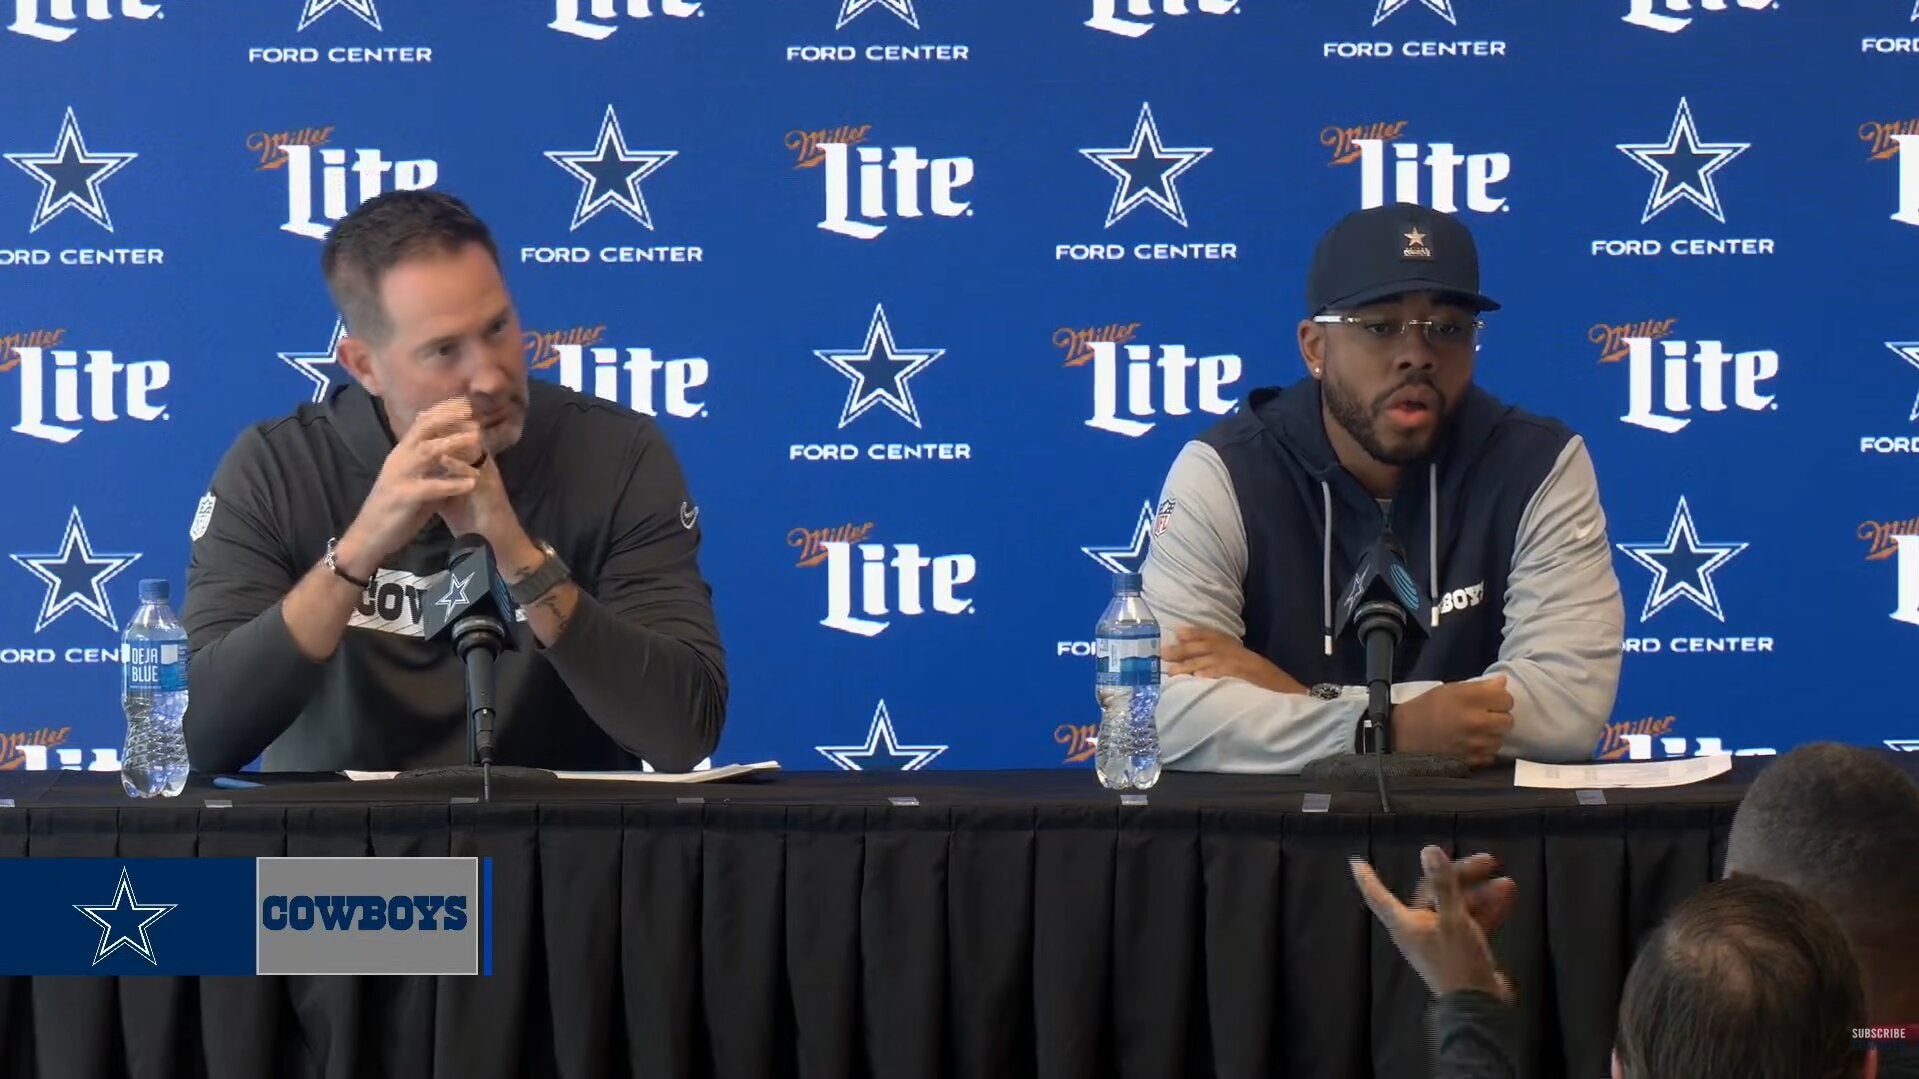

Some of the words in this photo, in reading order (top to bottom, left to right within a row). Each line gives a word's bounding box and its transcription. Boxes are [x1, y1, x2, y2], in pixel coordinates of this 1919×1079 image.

[249, 48, 318, 62] FORD
[328, 48, 432, 62] CENTER
[787, 47, 856, 61] FORD
[866, 46, 968, 60] CENTER
[1324, 43, 1393, 57] FORD
[1402, 42, 1505, 56] CENTER
[246, 126, 335, 171] Miller
[783, 122, 872, 169] Miller
[1320, 120, 1408, 166] Miller
[816, 142, 973, 238] Lite
[1349, 137, 1510, 213] Lite
[0, 250, 50, 264] ORD
[60, 249, 163, 264] CENTER
[522, 248, 590, 262] FORD
[600, 247, 702, 262] CENTER
[1056, 245, 1124, 259] FORD
[1134, 244, 1236, 259] CENTER
[1592, 240, 1661, 255] FORD
[1671, 239, 1774, 254] CENTER
[1052, 320, 1140, 366] Miller
[1589, 317, 1678, 363] Miller
[8, 345, 170, 443] Lite
[1085, 342, 1241, 437] Lite
[1620, 338, 1778, 433] Lite
[790, 445, 858, 460] FORD
[868, 444, 970, 459] CENTER
[786, 521, 874, 567] Miller
[820, 542, 975, 636] Lite
[0, 649, 55, 663] ORD
[65, 646, 122, 662] CEN
[132, 648, 157, 664] DEJA
[1671, 638, 1773, 652] CENTER
[132, 666, 158, 682] BLUE
